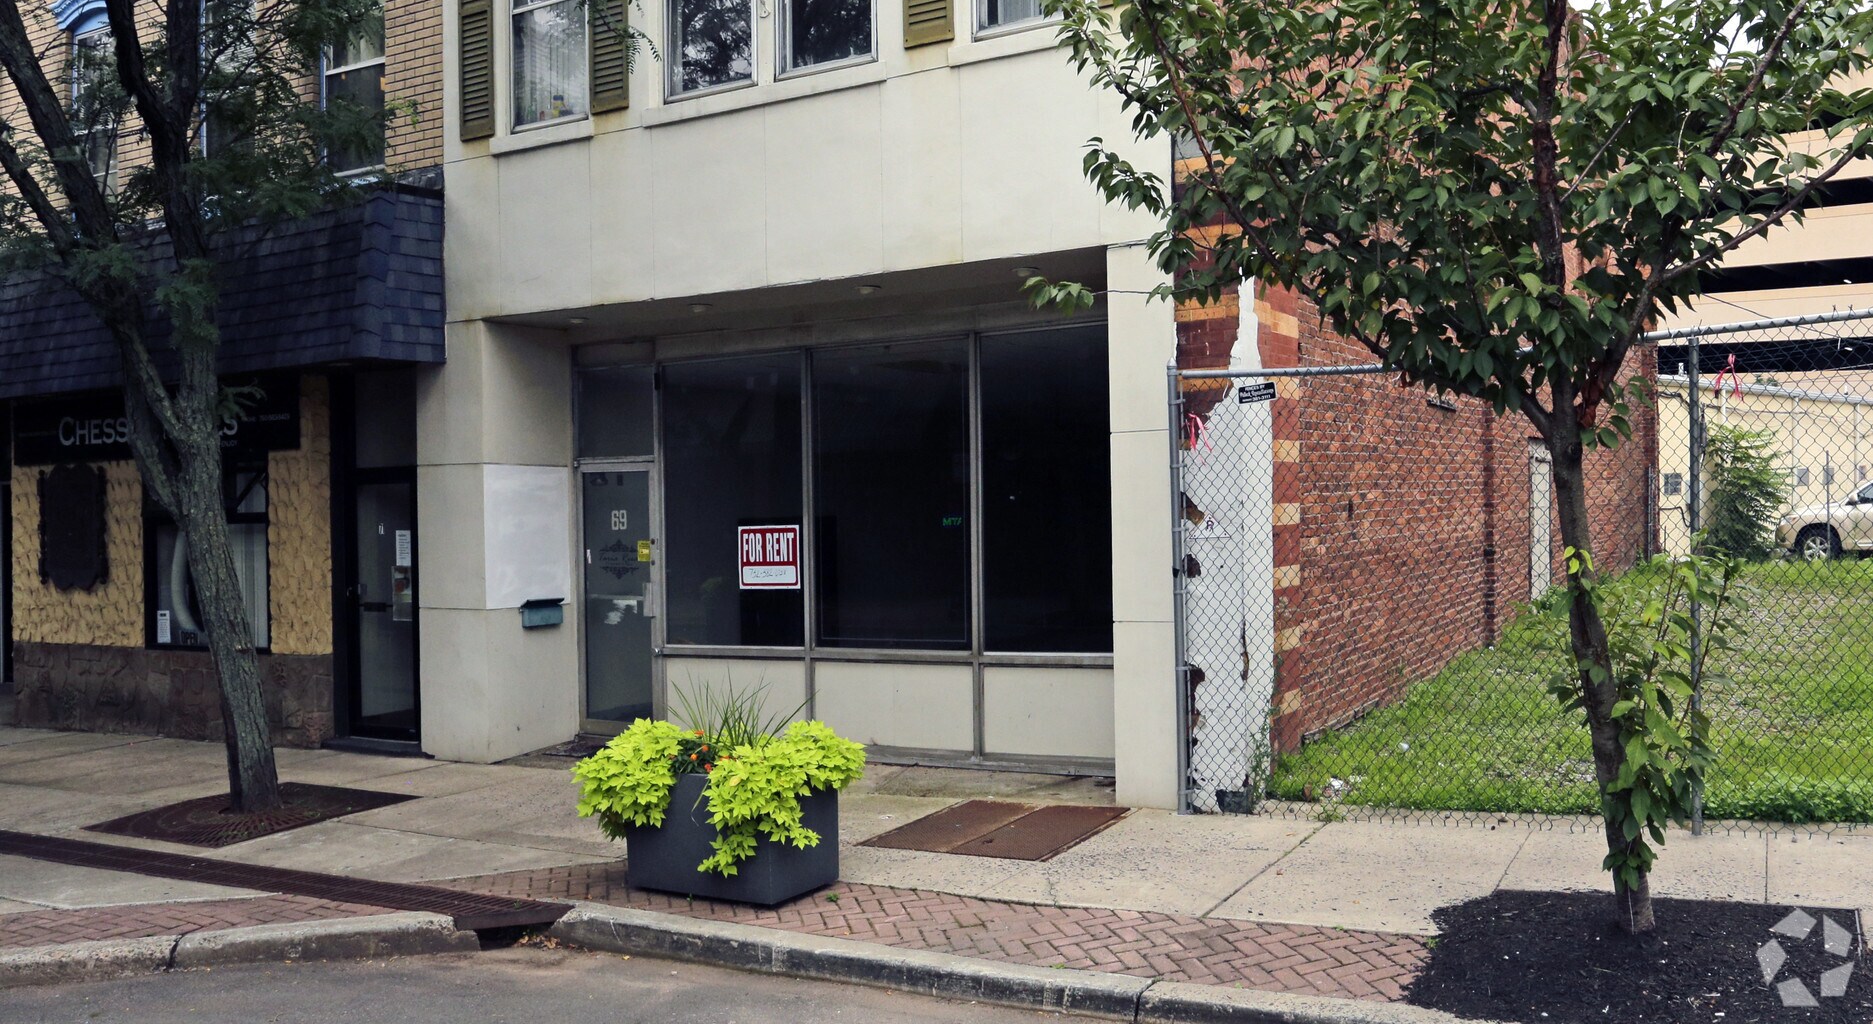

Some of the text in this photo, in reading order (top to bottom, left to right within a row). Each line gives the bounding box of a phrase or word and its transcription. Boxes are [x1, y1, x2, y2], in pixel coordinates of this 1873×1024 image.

[58, 417, 128, 446] CHESS
[611, 509, 627, 531] 69
[743, 532, 794, 563] FOR RENT
